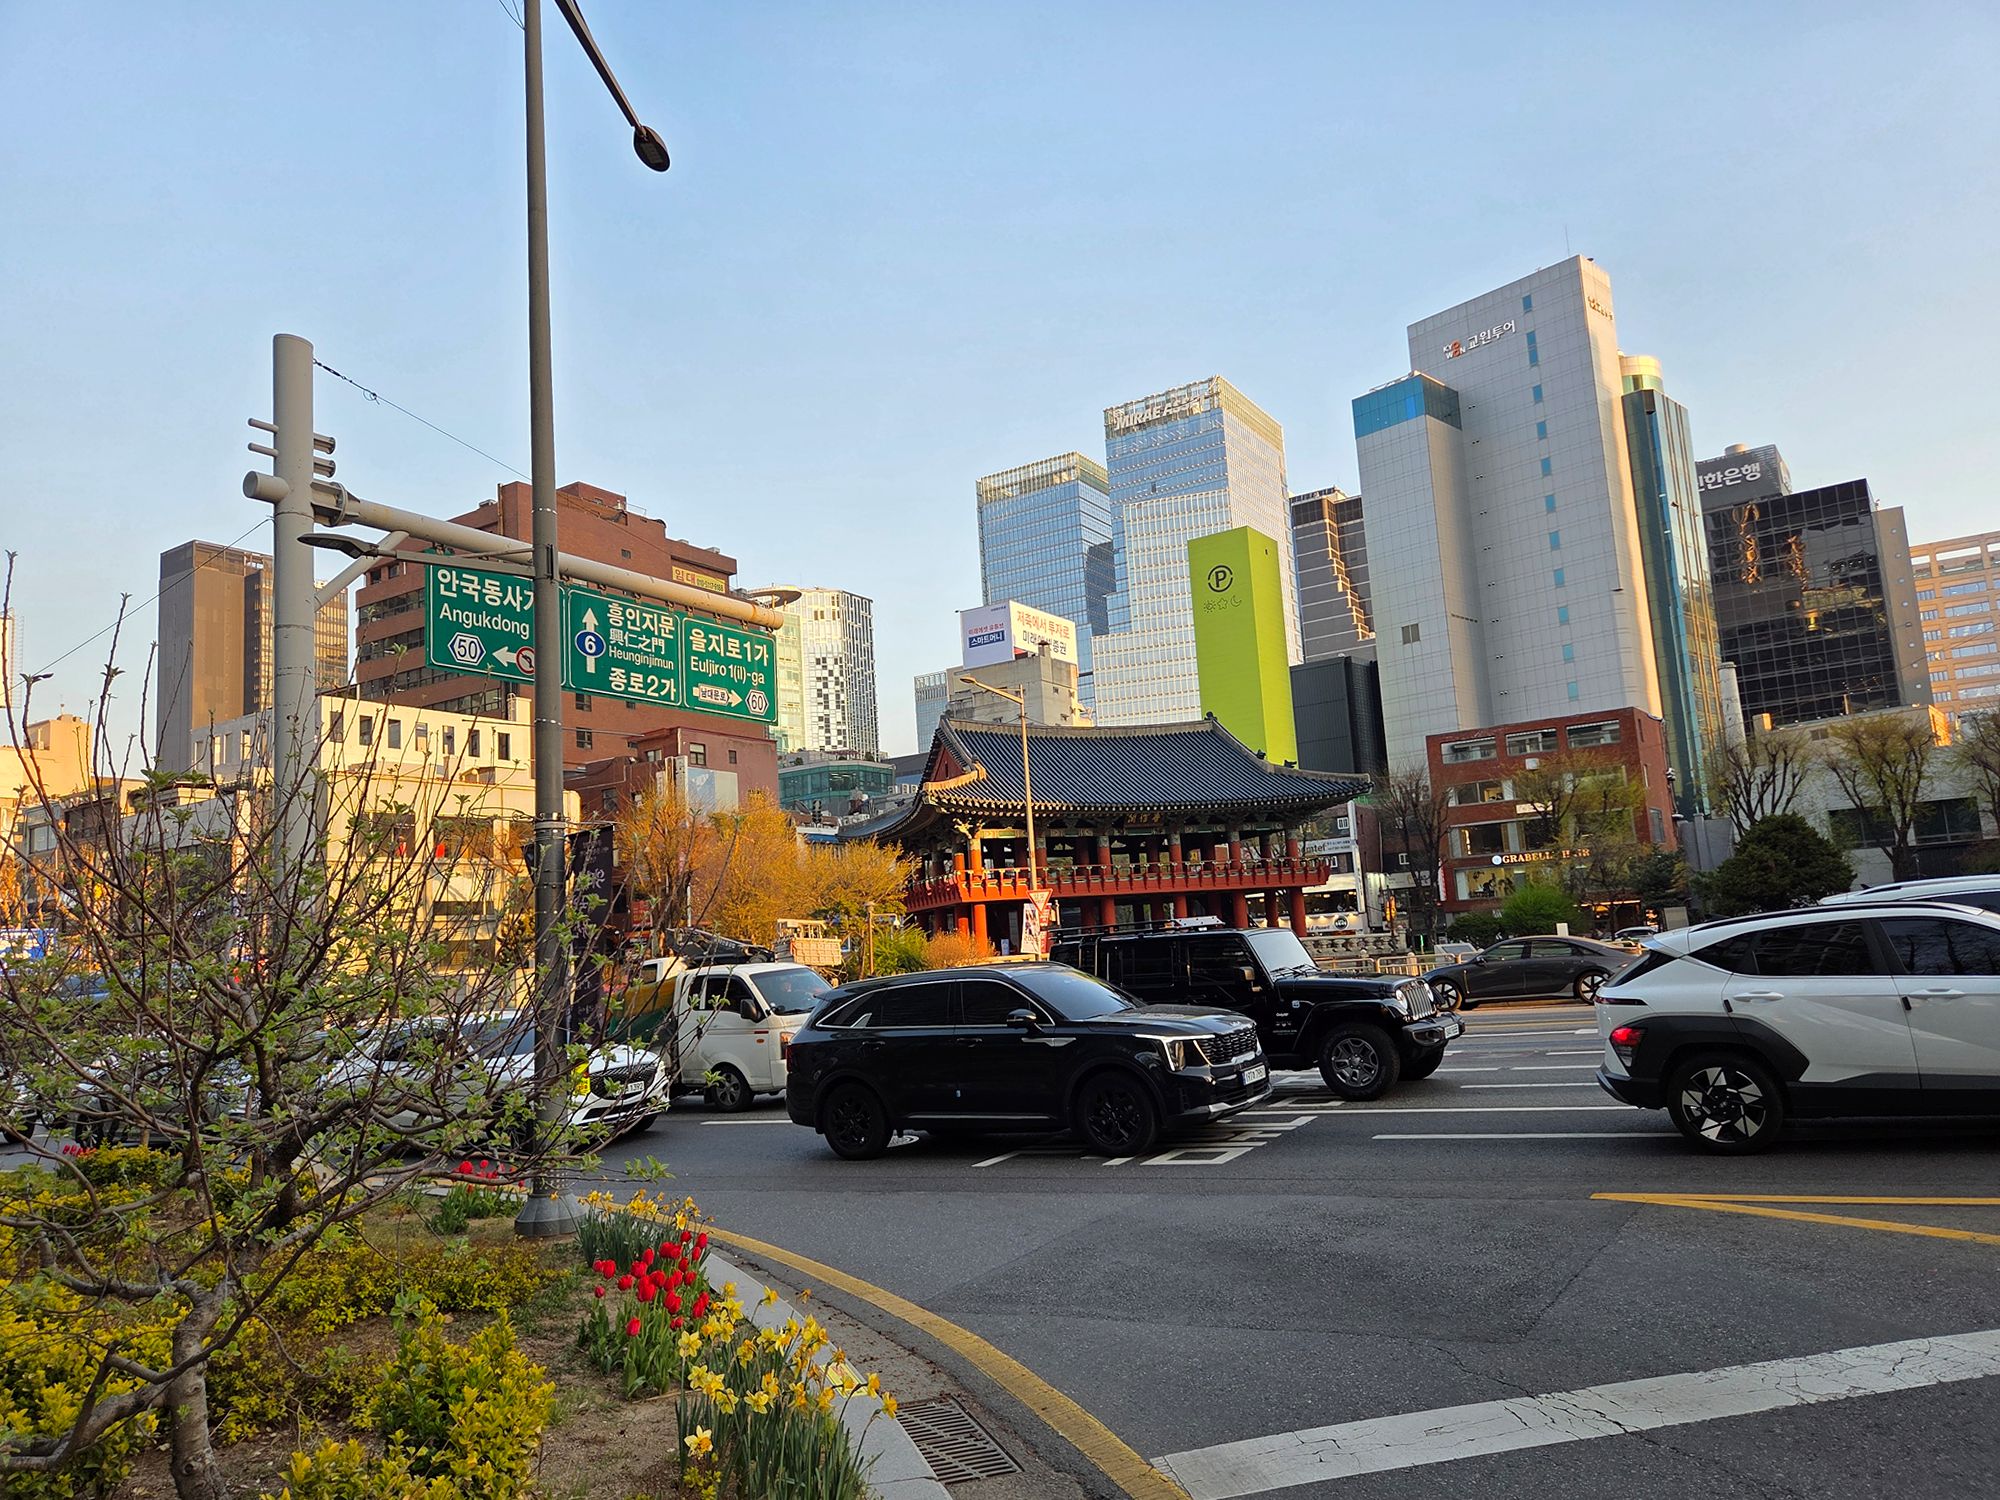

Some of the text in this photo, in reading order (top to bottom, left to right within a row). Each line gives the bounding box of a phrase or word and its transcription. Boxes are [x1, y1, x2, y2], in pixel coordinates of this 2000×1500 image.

[1468, 320, 1515, 350] 교원투어
[1114, 405, 1161, 431] MIRAE
[440, 603, 530, 640] Angukdong
[607, 602, 675, 639] 흥인지문
[1016, 611, 1070, 639] 저축에서 투자로
[457, 639, 478, 659] 50
[584, 635, 597, 654] 6
[609, 628, 665, 655] 興仁之門
[689, 628, 769, 667] 을지로1가
[608, 645, 674, 670] Heunginjimun
[690, 656, 766, 686] Euljiro 1(il)-ga
[608, 667, 676, 701] 종로2가
[701, 687, 727, 701] 남대문로
[751, 694, 764, 711] 60
[1562, 848, 1590, 858] HIR
